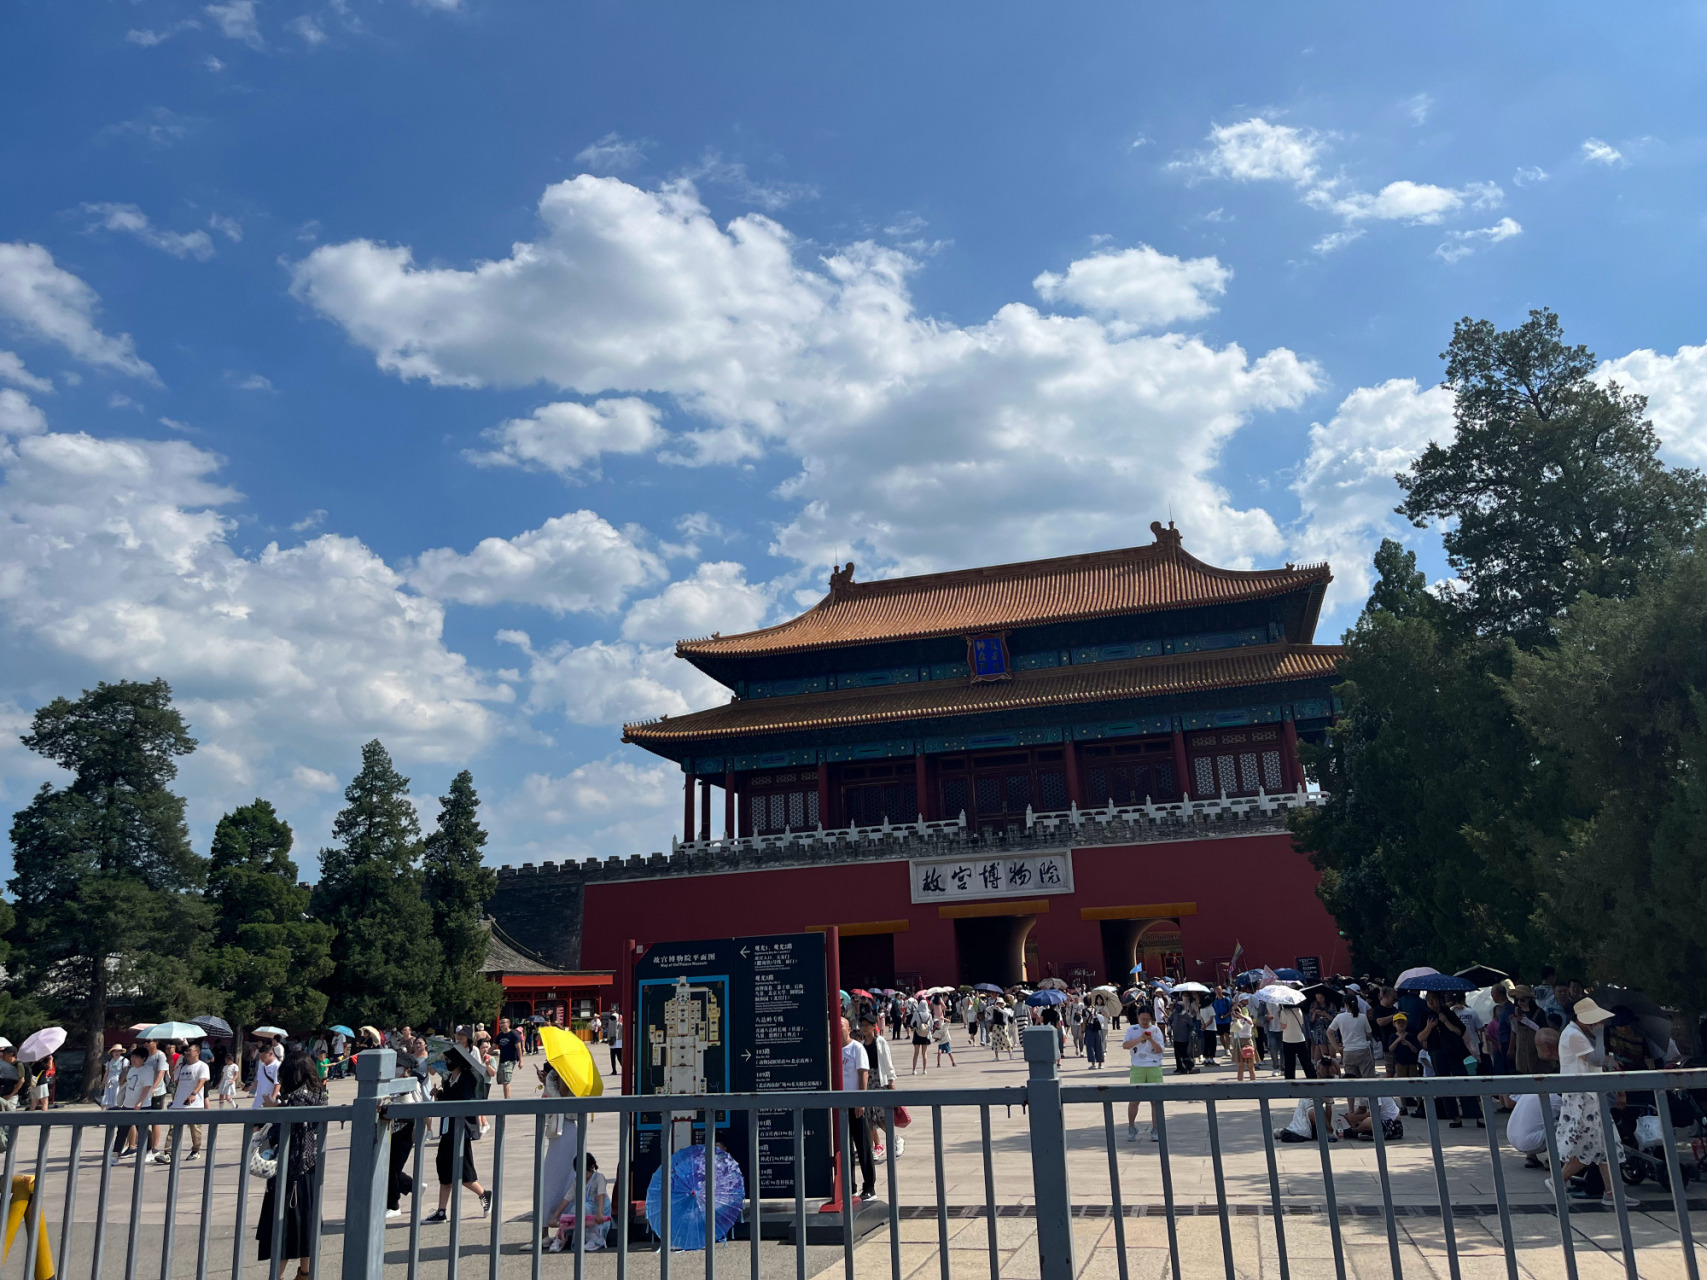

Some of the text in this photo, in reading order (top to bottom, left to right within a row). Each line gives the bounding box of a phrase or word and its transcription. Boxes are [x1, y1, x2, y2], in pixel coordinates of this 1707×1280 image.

[922, 859, 1061, 892] 故宫博物院
[653, 952, 716, 964] 故宫博物院平面图
